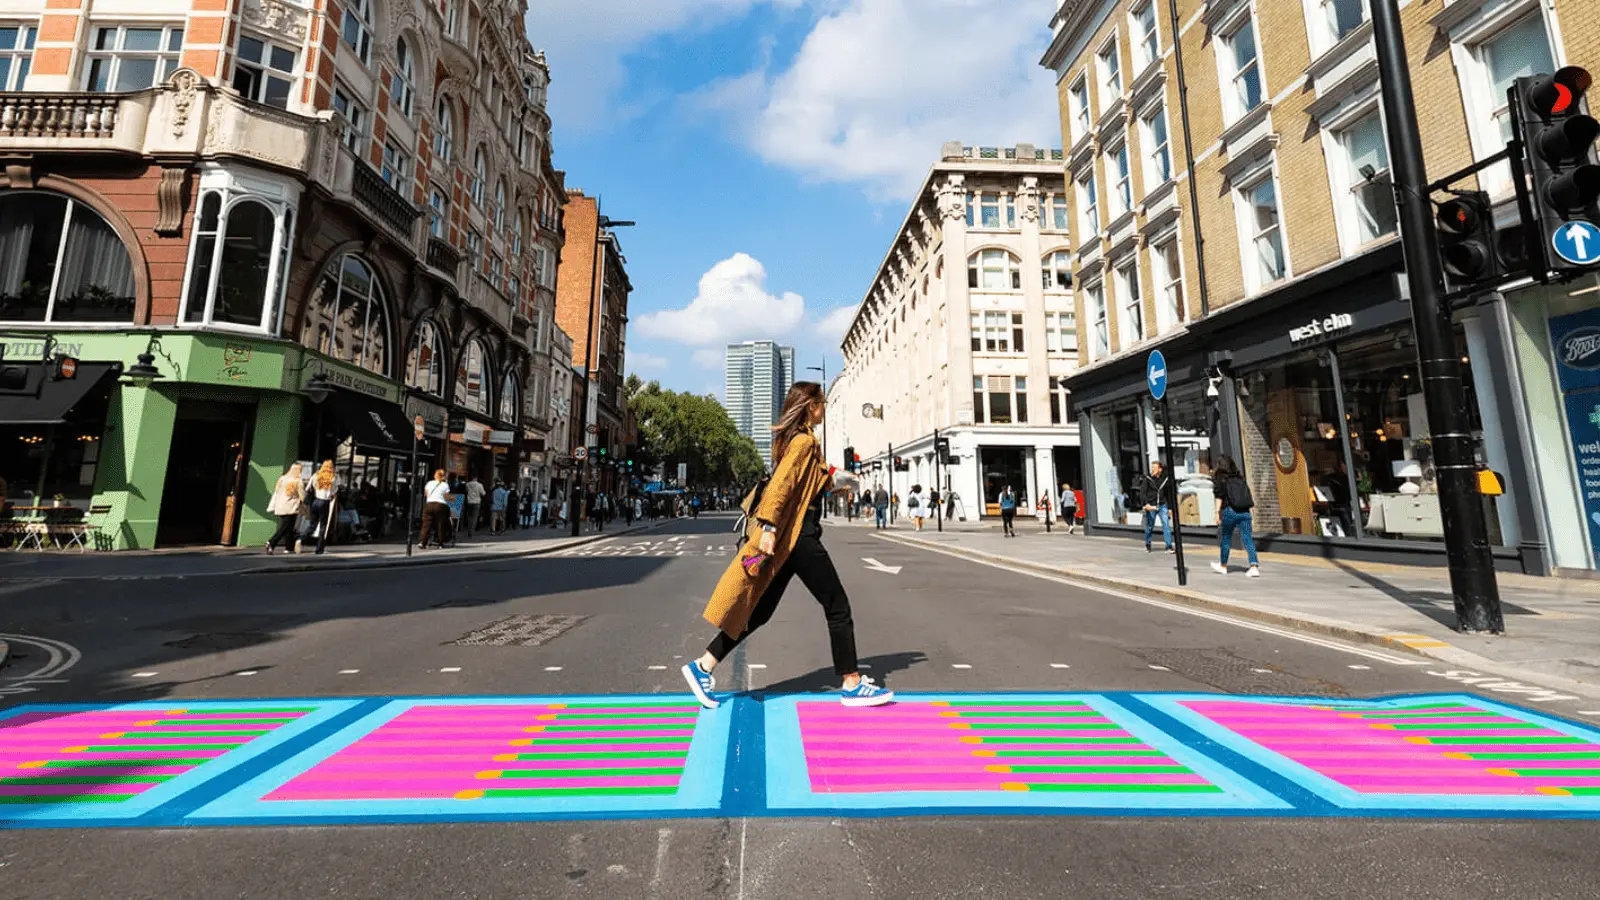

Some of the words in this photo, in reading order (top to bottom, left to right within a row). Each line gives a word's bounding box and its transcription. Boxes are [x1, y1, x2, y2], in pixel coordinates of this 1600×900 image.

[1289, 318, 1322, 342] west
[1323, 313, 1352, 332] elm
[5, 343, 83, 356] TIDEN
